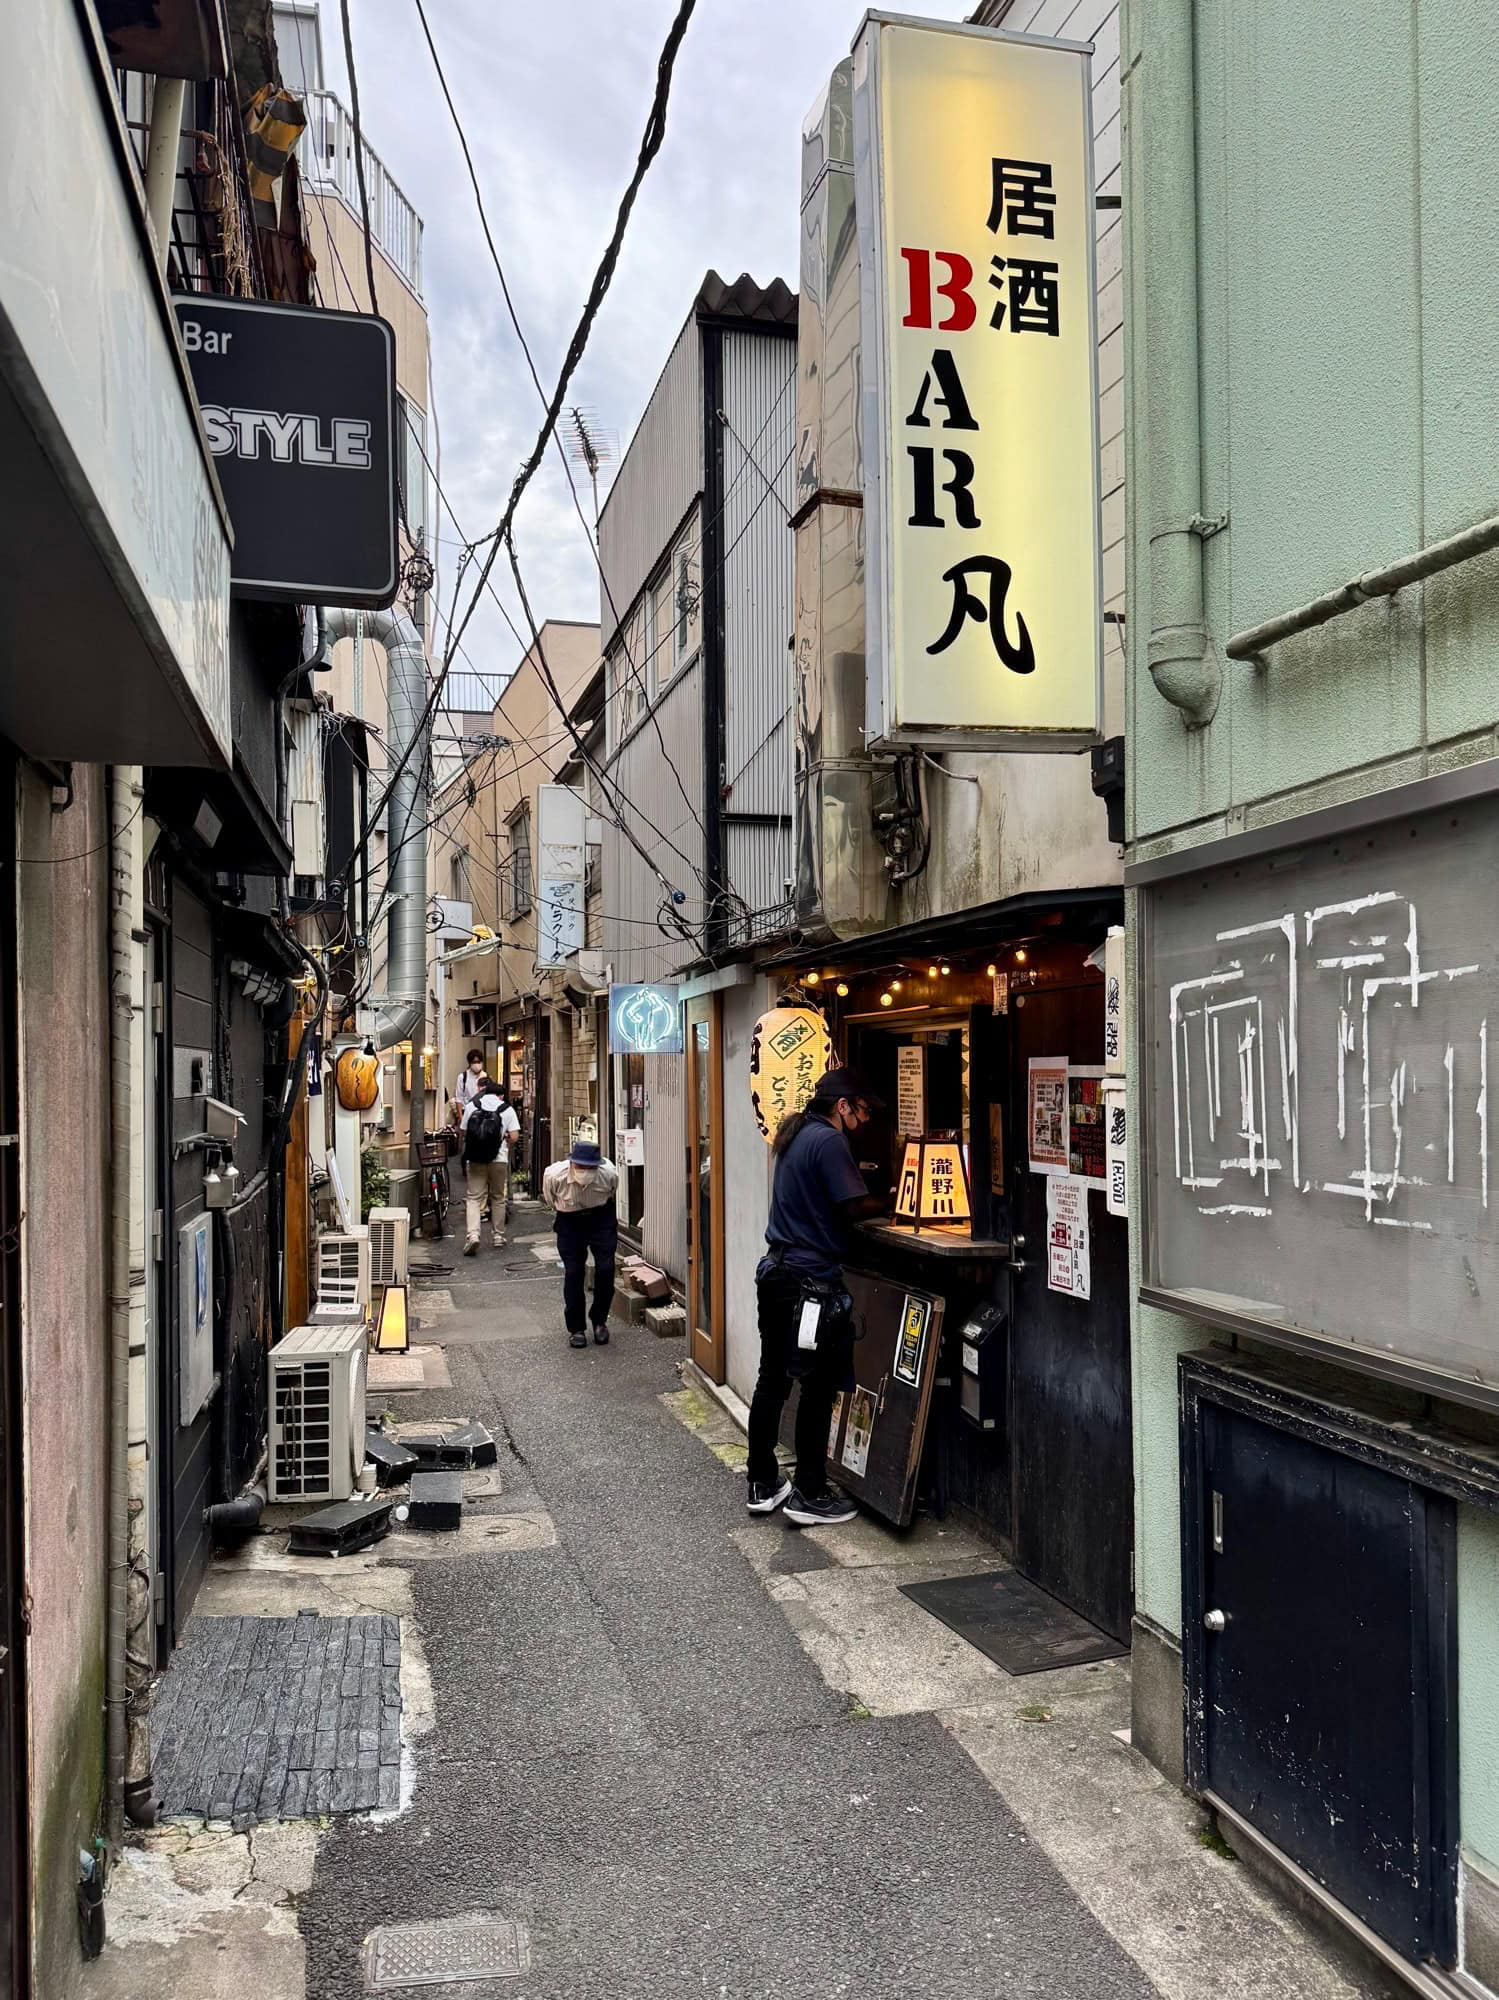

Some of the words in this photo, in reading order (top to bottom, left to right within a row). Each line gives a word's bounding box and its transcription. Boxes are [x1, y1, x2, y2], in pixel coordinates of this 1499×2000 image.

[985, 157, 1060, 338] 居酒
[182, 321, 232, 355] Bar
[200, 404, 371, 470] STYLE
[926, 555, 1036, 674] 凡
